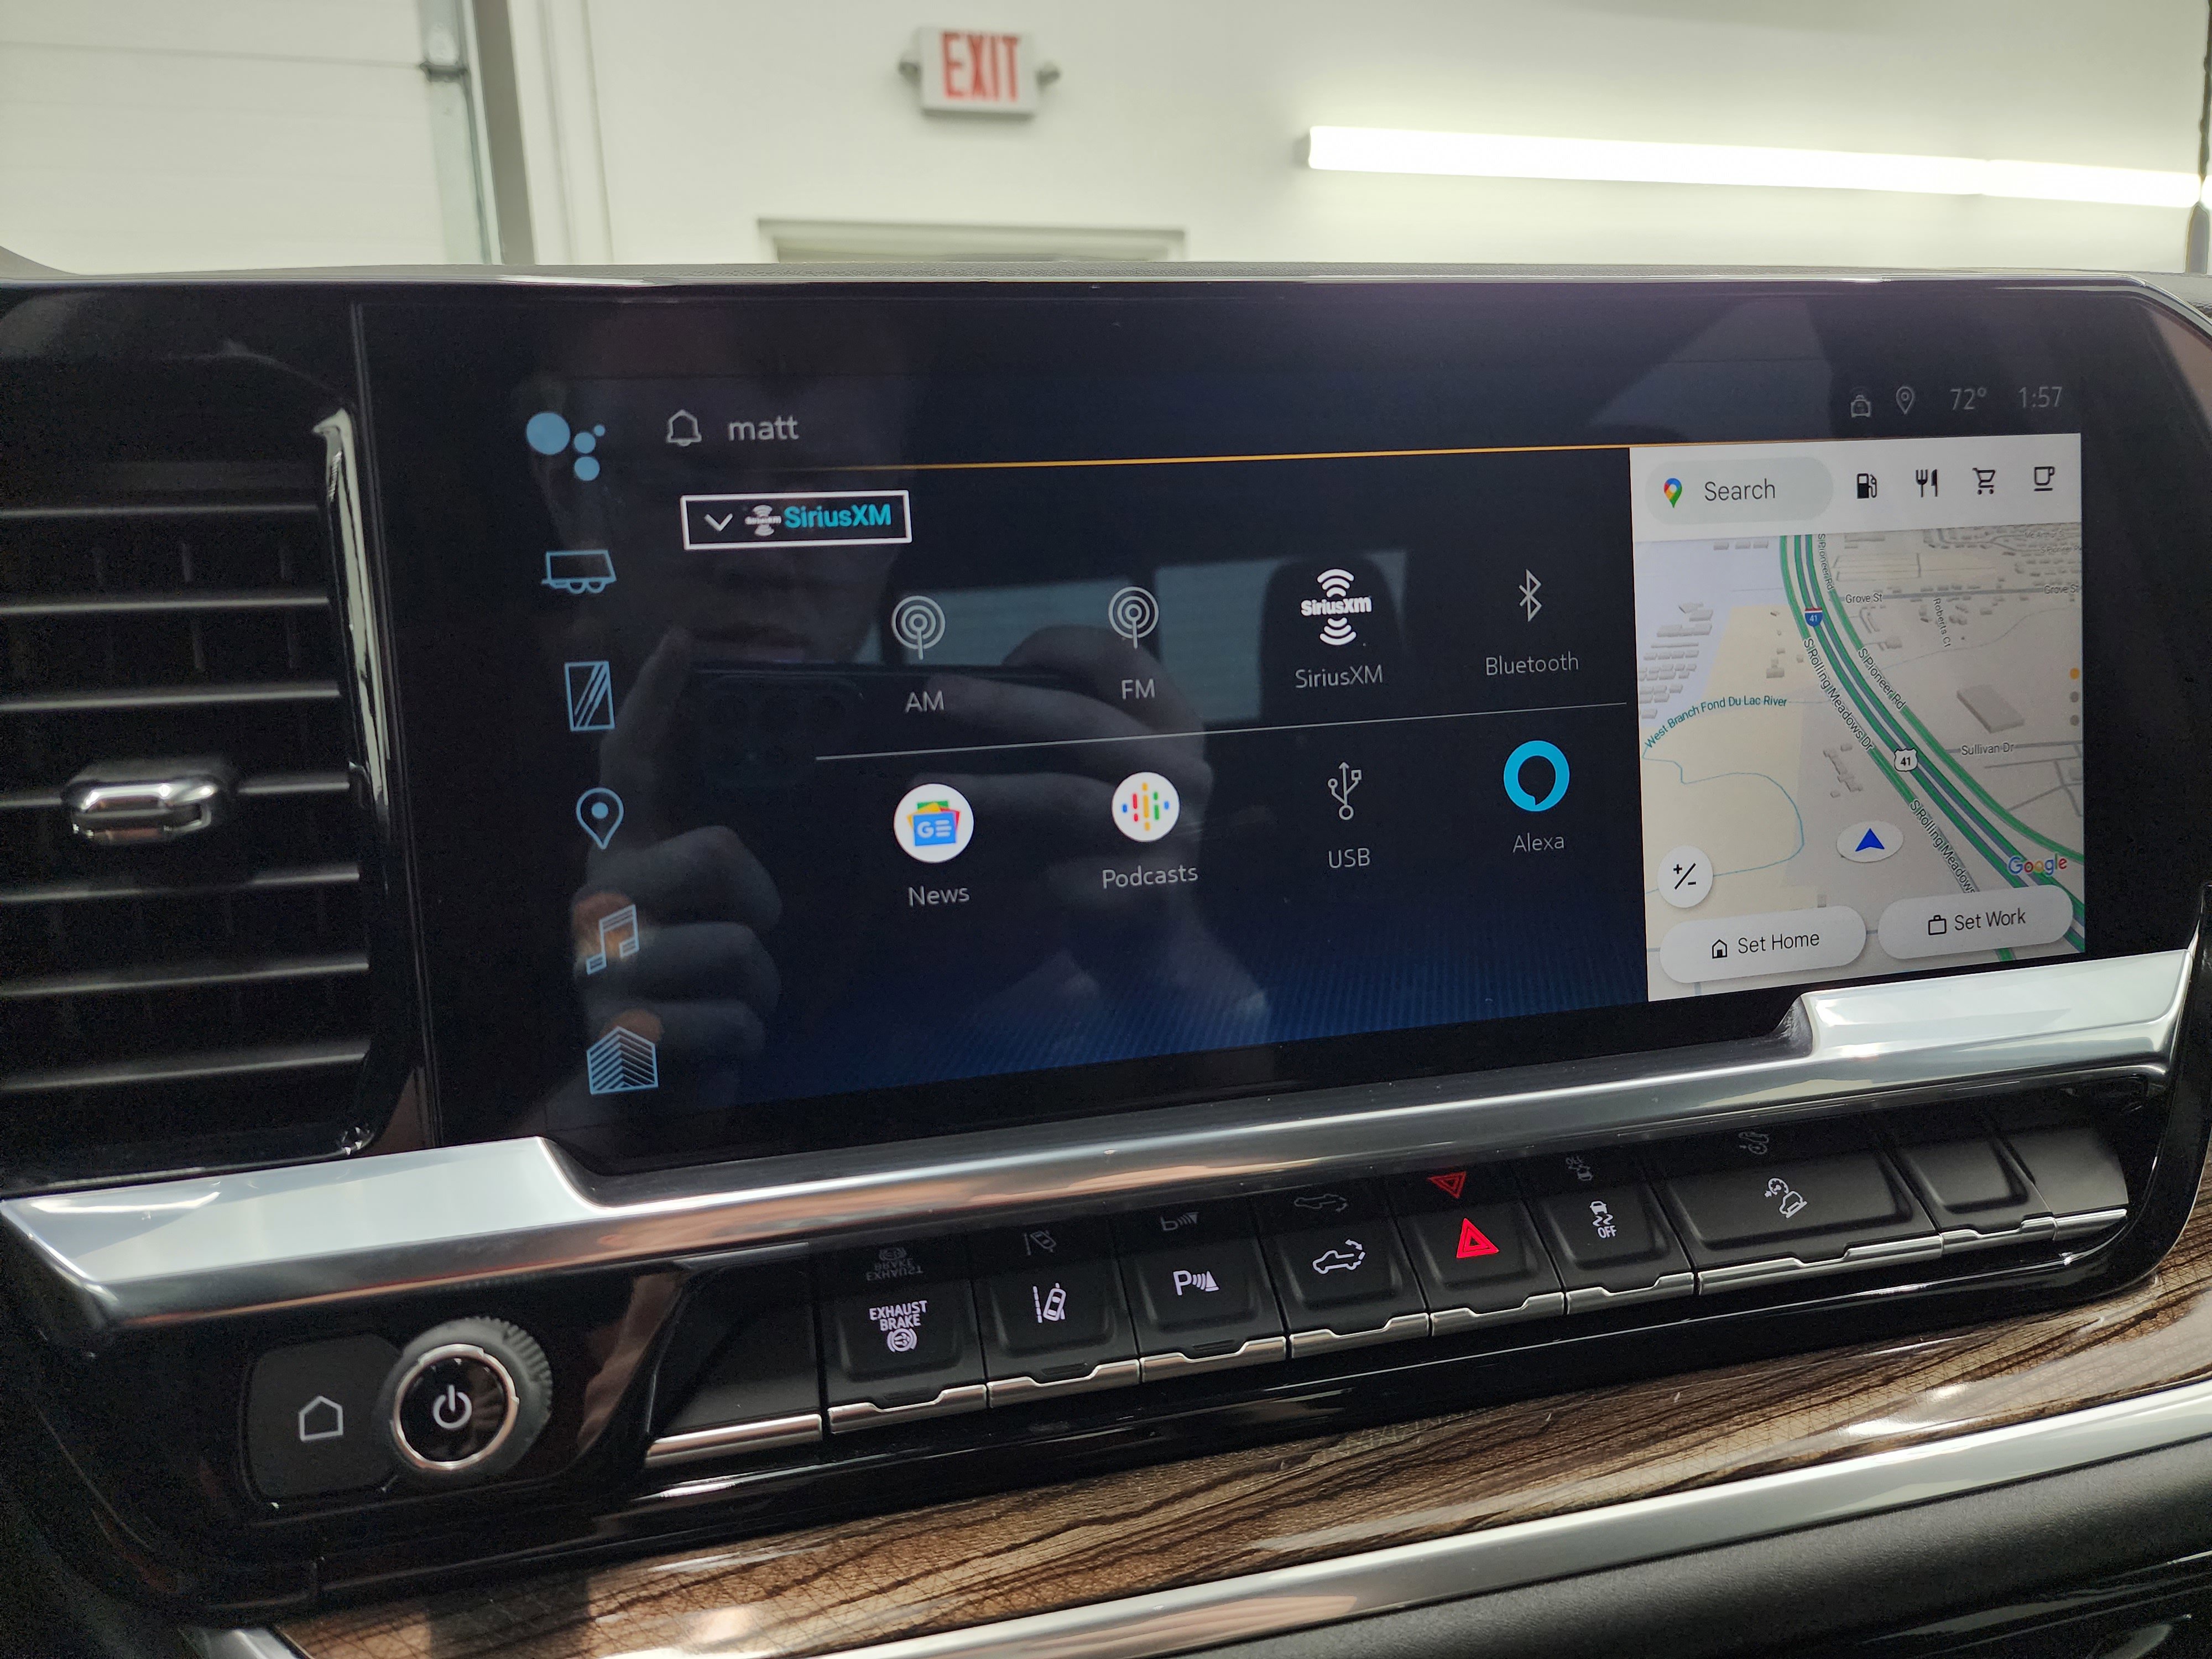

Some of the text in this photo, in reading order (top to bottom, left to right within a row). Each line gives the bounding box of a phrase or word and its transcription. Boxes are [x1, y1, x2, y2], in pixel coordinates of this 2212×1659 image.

[942, 32, 1019, 102] EXIT
[2019, 386, 2063, 408] 1:57
[728, 415, 800, 441] matt
[1704, 478, 1776, 502] Search
[784, 504, 891, 528] SiriusXM
[1818, 541, 1829, 576] Pioneer
[1825, 578, 1834, 590] Rd
[1845, 593, 1882, 603] Grove St
[2044, 585, 2068, 594] Grove
[1933, 598, 1952, 647] Roberts Ct
[1485, 651, 1579, 675] Bluetooth
[1295, 665, 1383, 688] SiriusXM
[1858, 648, 1906, 709] S Pioneer Rd
[1121, 679, 1155, 700] FM
[1804, 638, 1873, 750] S Rolling Meadows Dr
[904, 691, 945, 713] AM
[1645, 696, 1787, 748] West Branch Fond Du Lac River
[1961, 743, 2014, 755] Sullivan Dr
[1901, 757, 1911, 766] 41
[1910, 800, 1920, 811] S
[1916, 808, 1944, 848] Rolling
[1513, 832, 1565, 853] Alexa
[1328, 847, 1371, 869] USB
[2008, 853, 2068, 876] Google
[1102, 864, 1198, 889] Podcasts
[908, 886, 970, 906] News
[1954, 908, 2026, 931] Set Work
[1738, 933, 1820, 954] Set Home
[1598, 1225, 1617, 1238] OFF
[869, 1300, 927, 1321] EXHAUST
[880, 1313, 921, 1331] BRAKE
